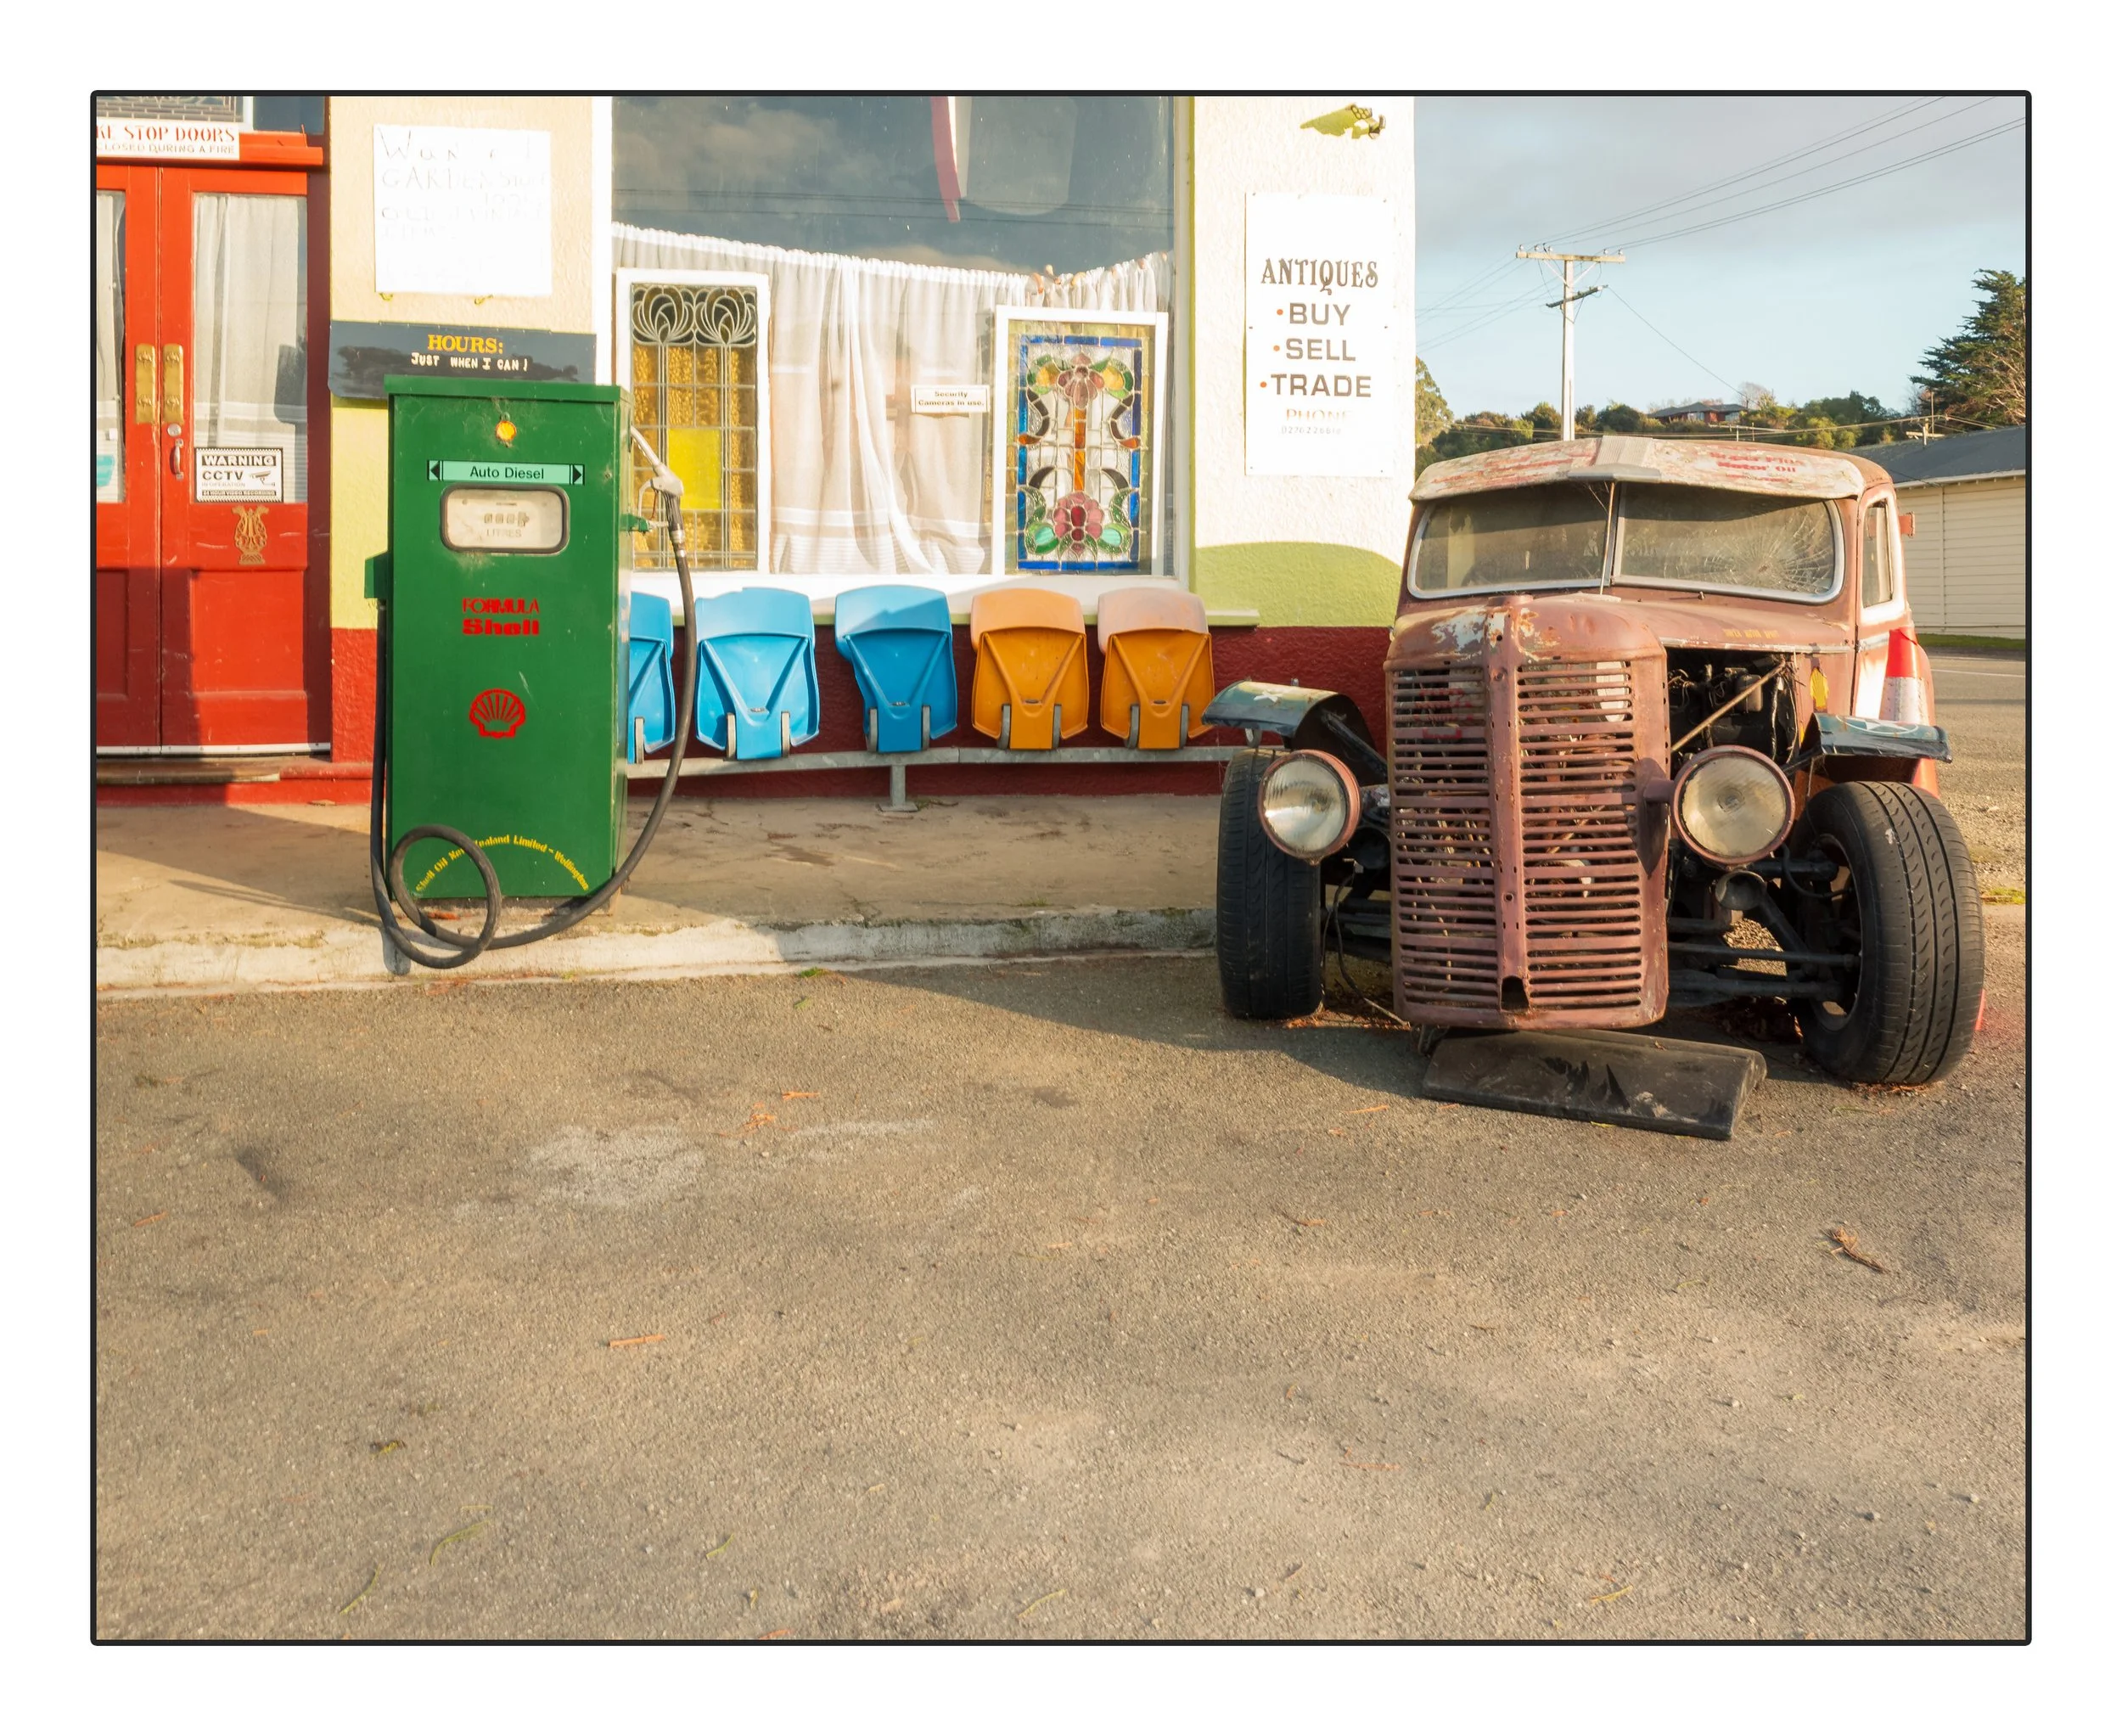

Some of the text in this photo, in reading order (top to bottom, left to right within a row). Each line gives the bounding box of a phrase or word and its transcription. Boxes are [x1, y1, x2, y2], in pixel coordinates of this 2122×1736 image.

[124, 125, 169, 141] STOP
[176, 126, 235, 143] DOORS
[149, 143, 194, 154] DURING
[210, 145, 235, 154] FIRE
[1260, 258, 1378, 295] ANTIQUES
[1289, 303, 1350, 326] BUY
[427, 334, 503, 354] HOURS:
[1286, 338, 1356, 362] SELL
[450, 357, 479, 369] WHEN
[482, 357, 491, 371] I
[1271, 374, 1372, 397] TRADE
[204, 455, 275, 466] WARNING
[202, 470, 244, 480] CCTV
[469, 466, 545, 480] Auto Diesel
[462, 598, 541, 614] FORMULA
[463, 618, 541, 635] Shell
[434, 857, 449, 873] Oil
[514, 834, 548, 853] Limited
